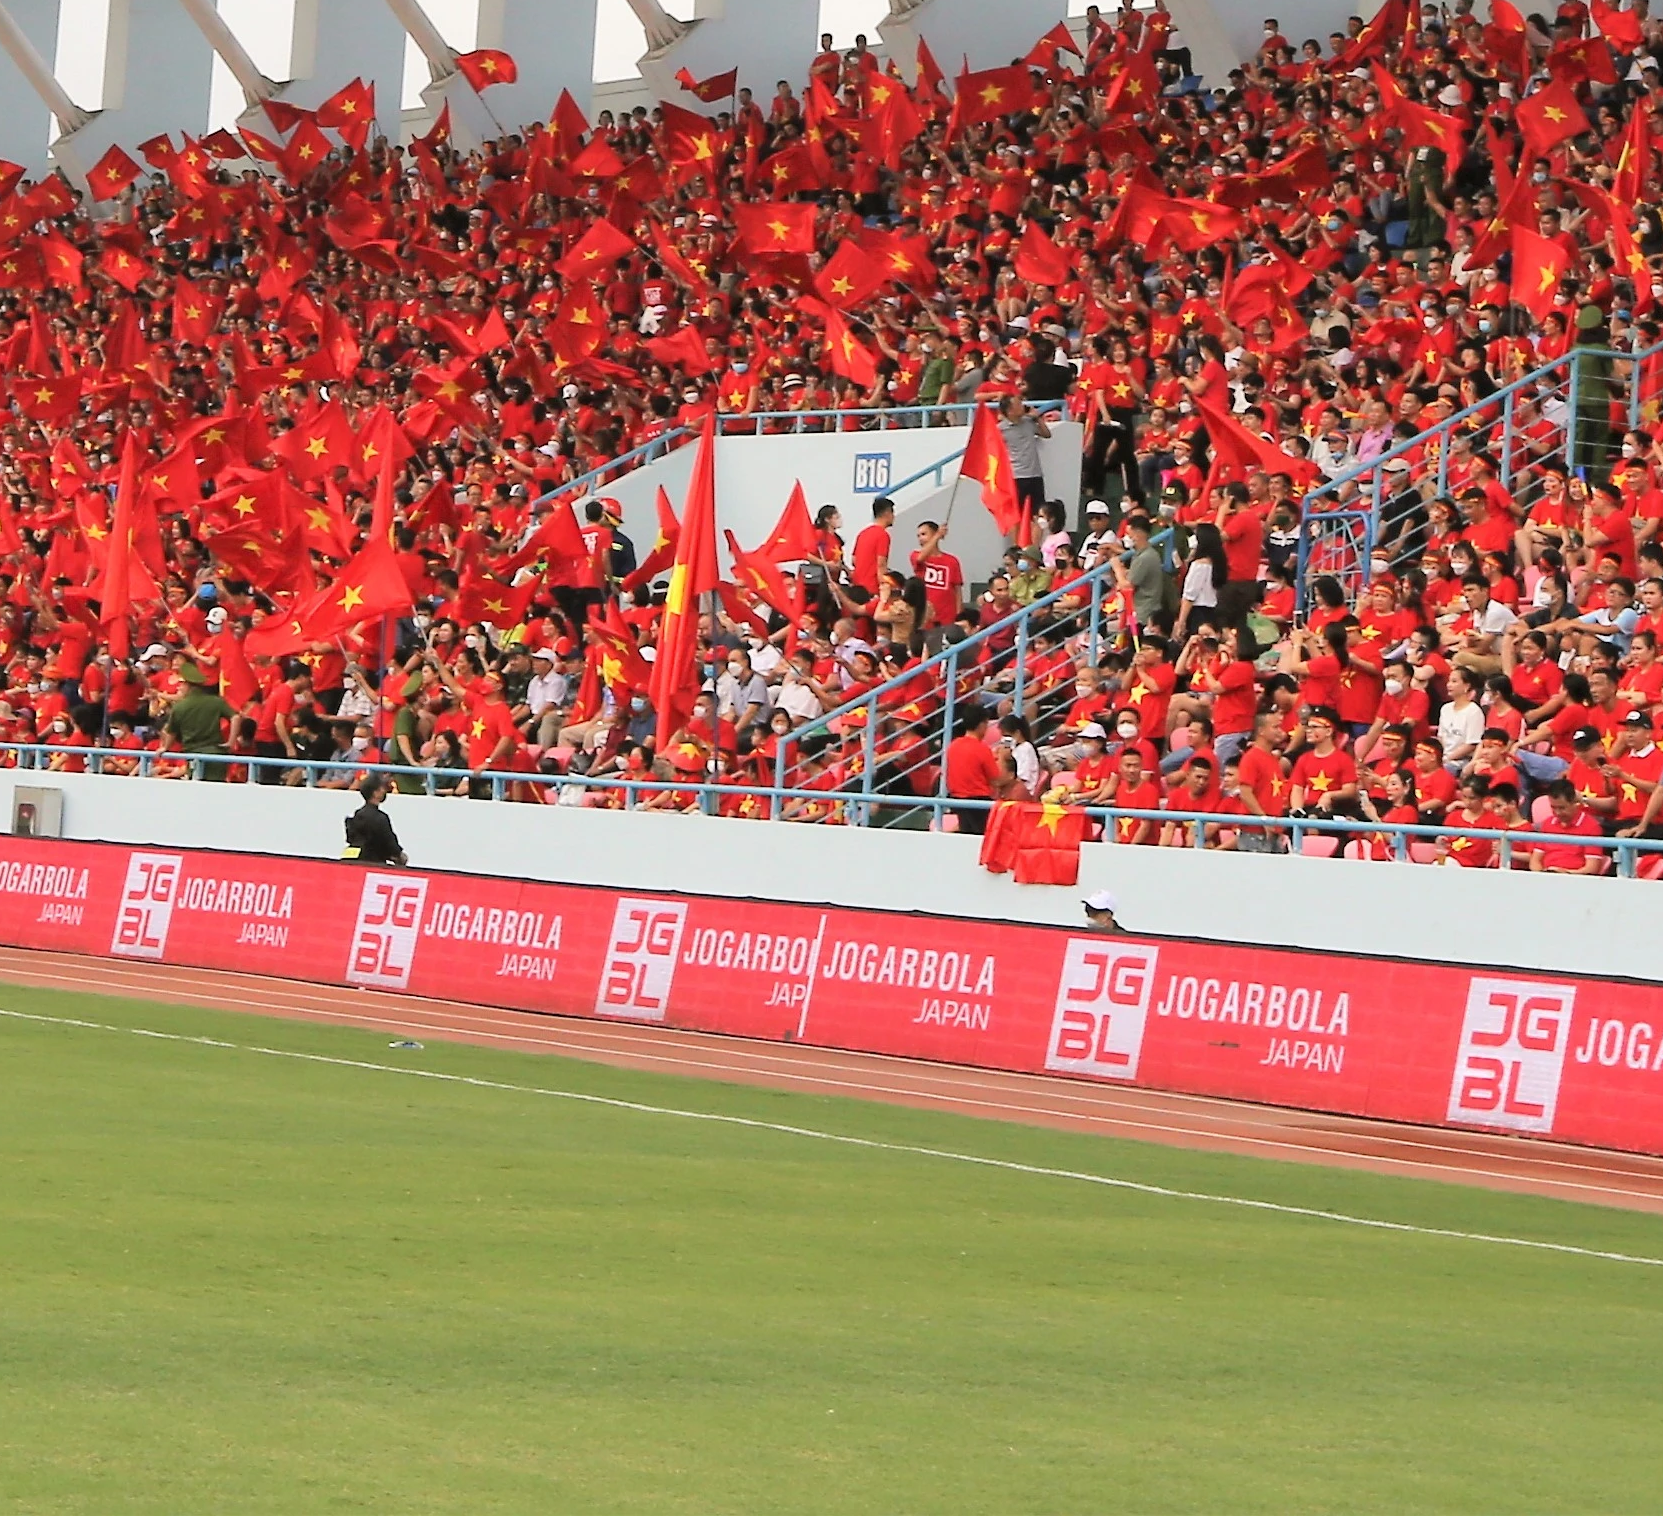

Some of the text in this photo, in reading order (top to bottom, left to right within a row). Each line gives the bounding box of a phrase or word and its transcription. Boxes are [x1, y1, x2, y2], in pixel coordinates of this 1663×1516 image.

[855, 457, 889, 489] B16
[36, 903, 84, 926] JAPAN
[177, 877, 293, 919] JOGARBOLA
[235, 922, 289, 948] JAPAN
[423, 902, 562, 951] JOGARBOLA
[495, 953, 557, 981] JAPAN
[822, 941, 995, 996] JOGARBOLA
[912, 998, 991, 1031] JAPAN
[1157, 975, 1349, 1036] JOGARBOLA
[1259, 1037, 1344, 1074] JAPAN
